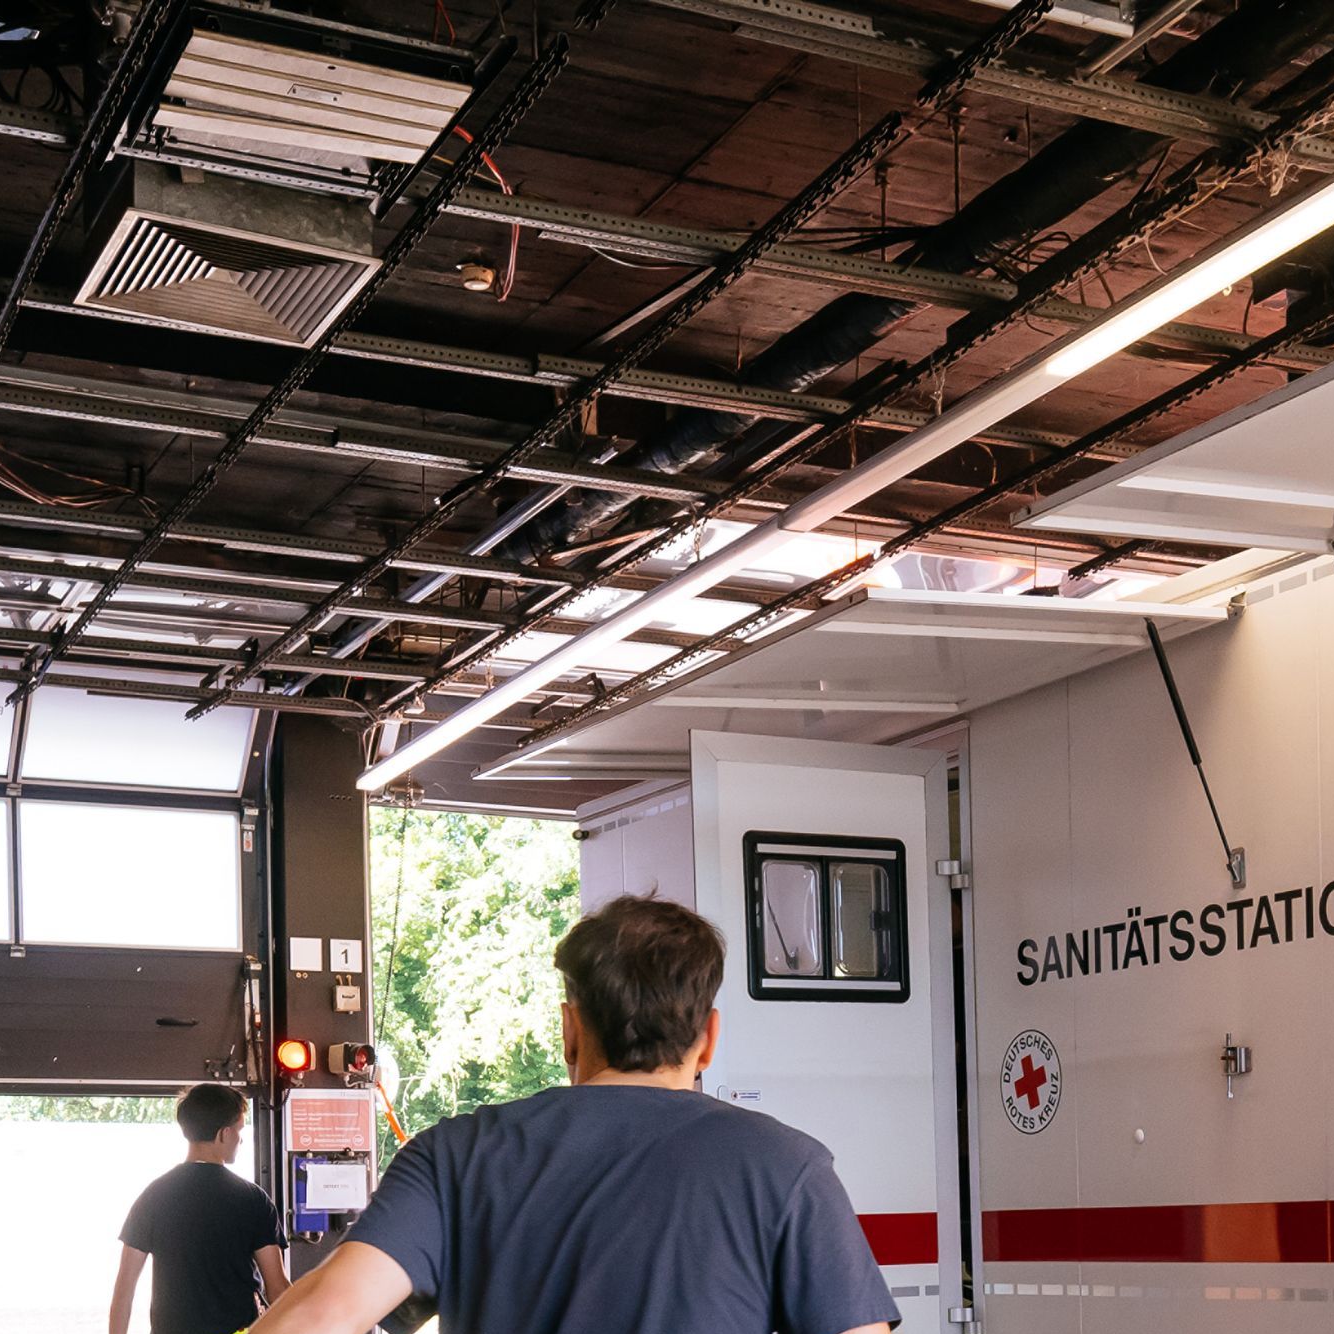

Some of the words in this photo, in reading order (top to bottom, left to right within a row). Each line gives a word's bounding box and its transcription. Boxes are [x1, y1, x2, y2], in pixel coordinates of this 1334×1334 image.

[341, 948, 348, 965] 1
[1002, 1034, 1053, 1084] DEUTSCHES
[1005, 1095, 1035, 1129] ROTES
[1037, 1071, 1059, 1125] KREUZ
